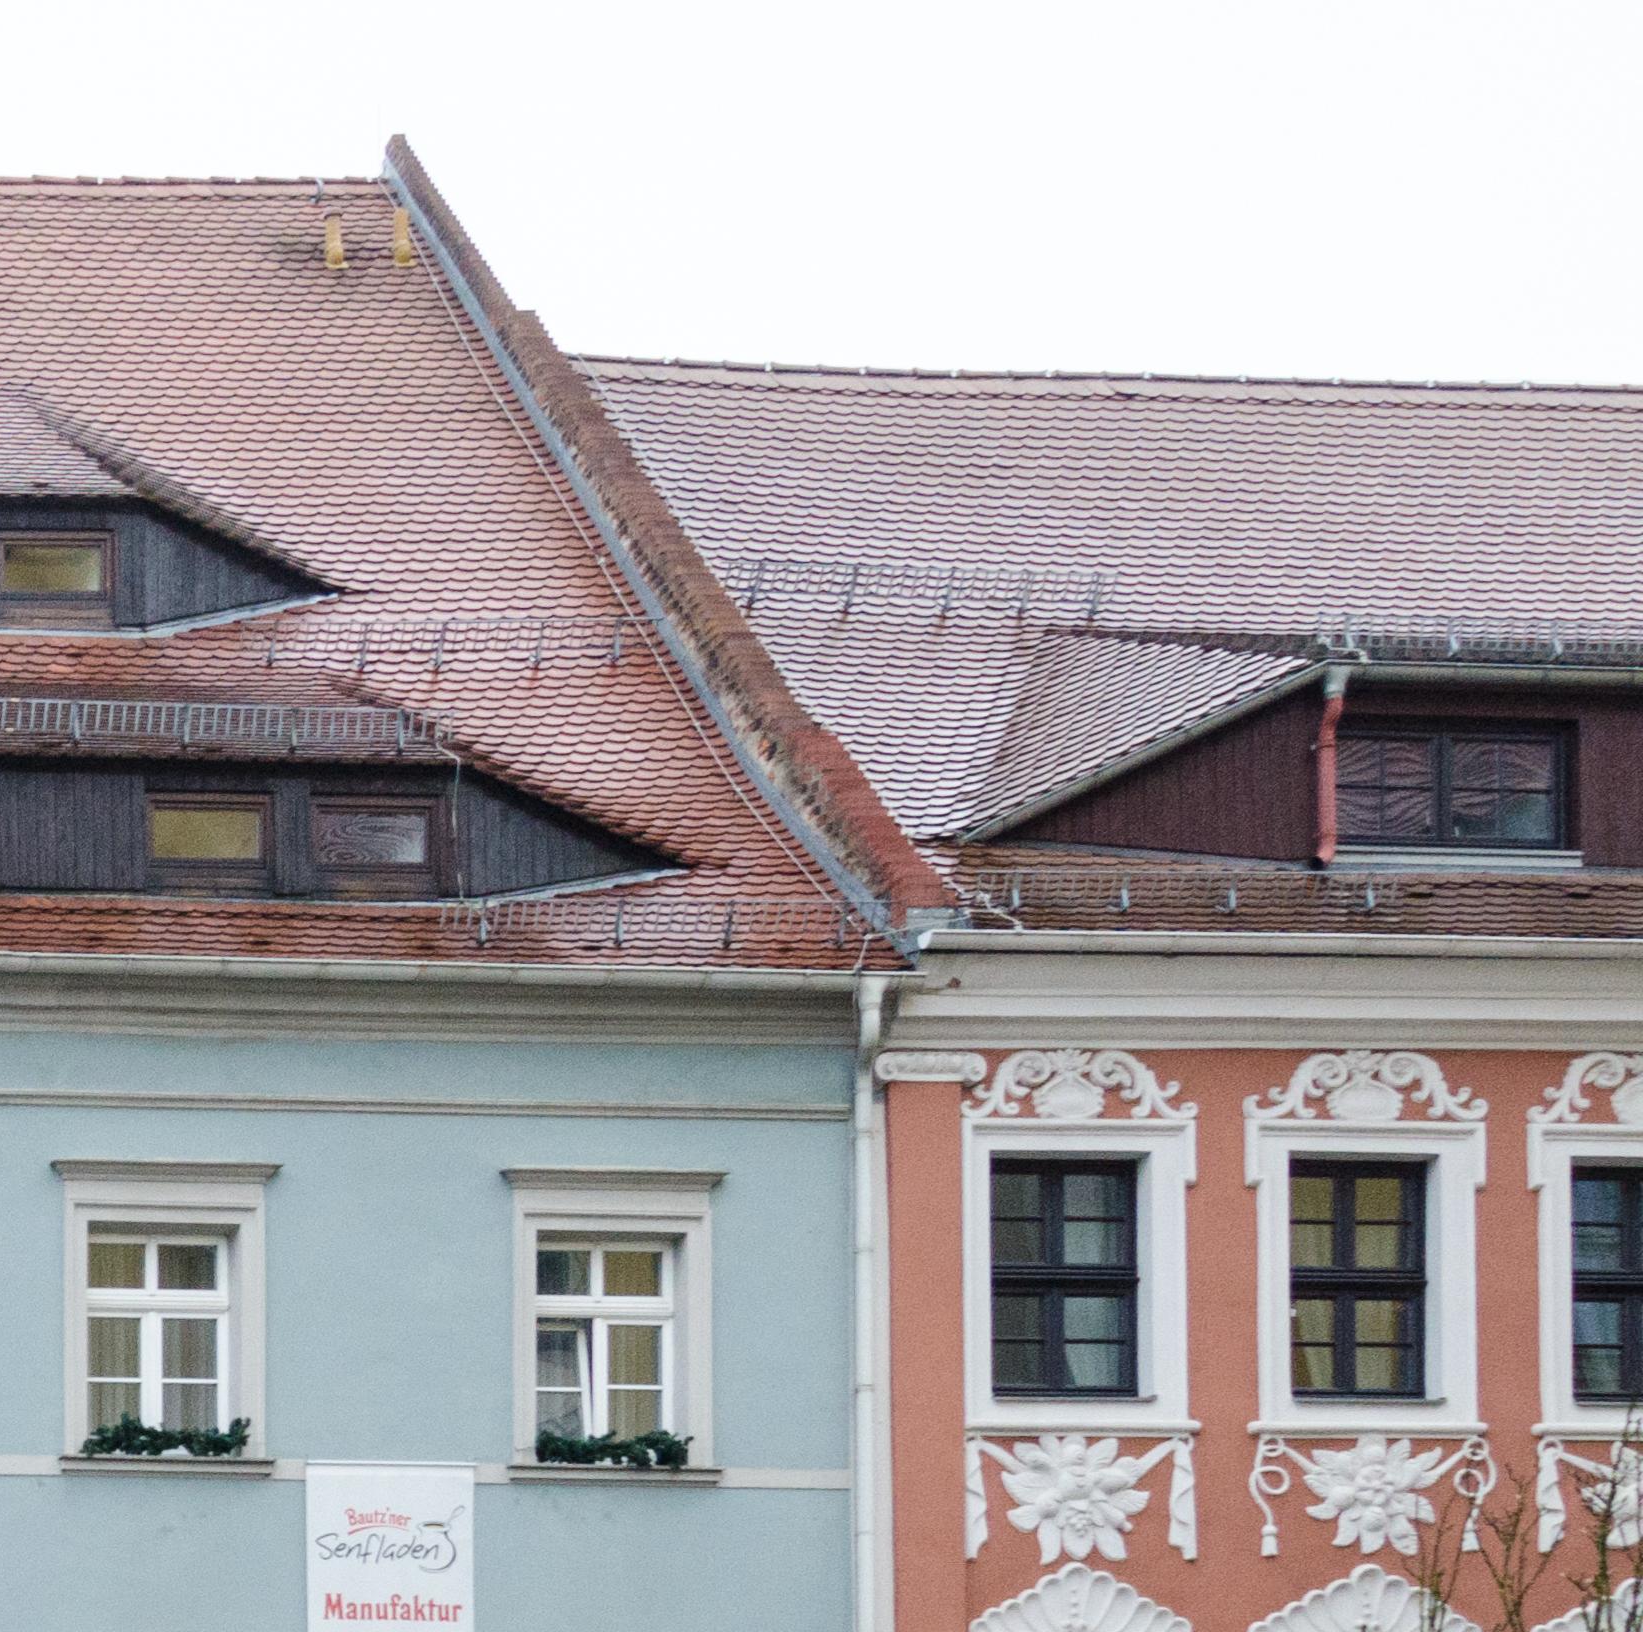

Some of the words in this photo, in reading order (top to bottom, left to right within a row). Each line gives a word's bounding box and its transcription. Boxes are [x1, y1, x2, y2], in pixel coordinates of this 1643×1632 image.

[345, 1507, 412, 1526] Bautz'ner
[315, 1532, 440, 1564] Senfladen
[323, 1592, 463, 1622] Manufaktur
